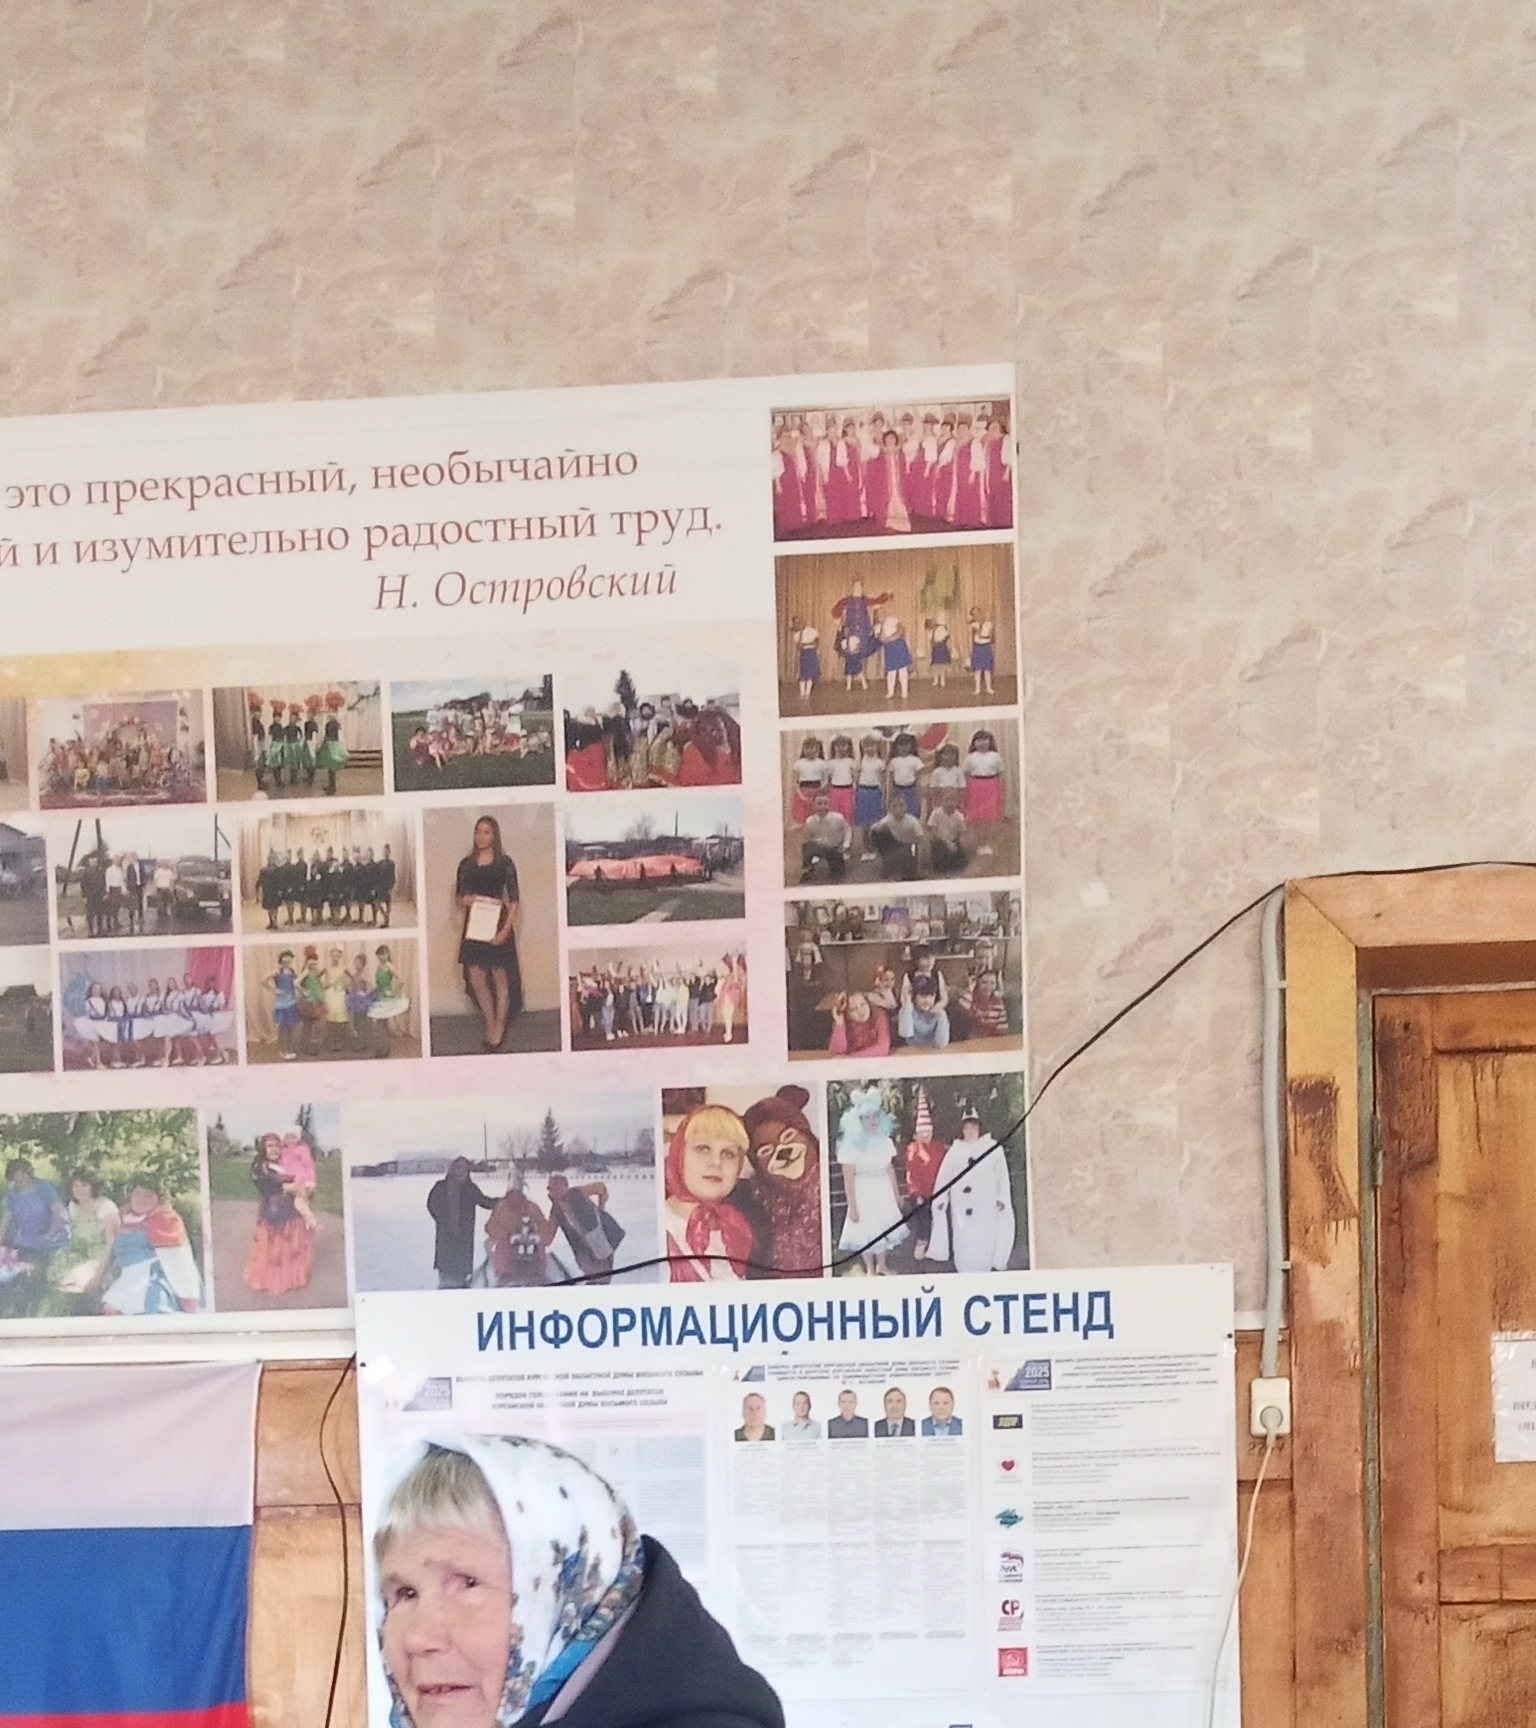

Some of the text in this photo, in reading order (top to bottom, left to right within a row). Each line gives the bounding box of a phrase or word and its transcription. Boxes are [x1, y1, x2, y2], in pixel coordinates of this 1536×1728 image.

[6, 482, 71, 511] это
[85, 461, 357, 514] прекрасный,
[371, 447, 639, 491] необычайно
[33, 540, 60, 567] и
[74, 526, 348, 572] изумительно
[363, 505, 597, 561] радостный
[609, 501, 722, 546] труд.
[375, 563, 677, 614] Н. Островский
[476, 1286, 1115, 1352] ИНФОРМАЦИОННЫЙ СТЕНД
[1025, 1367, 1049, 1378] 2025
